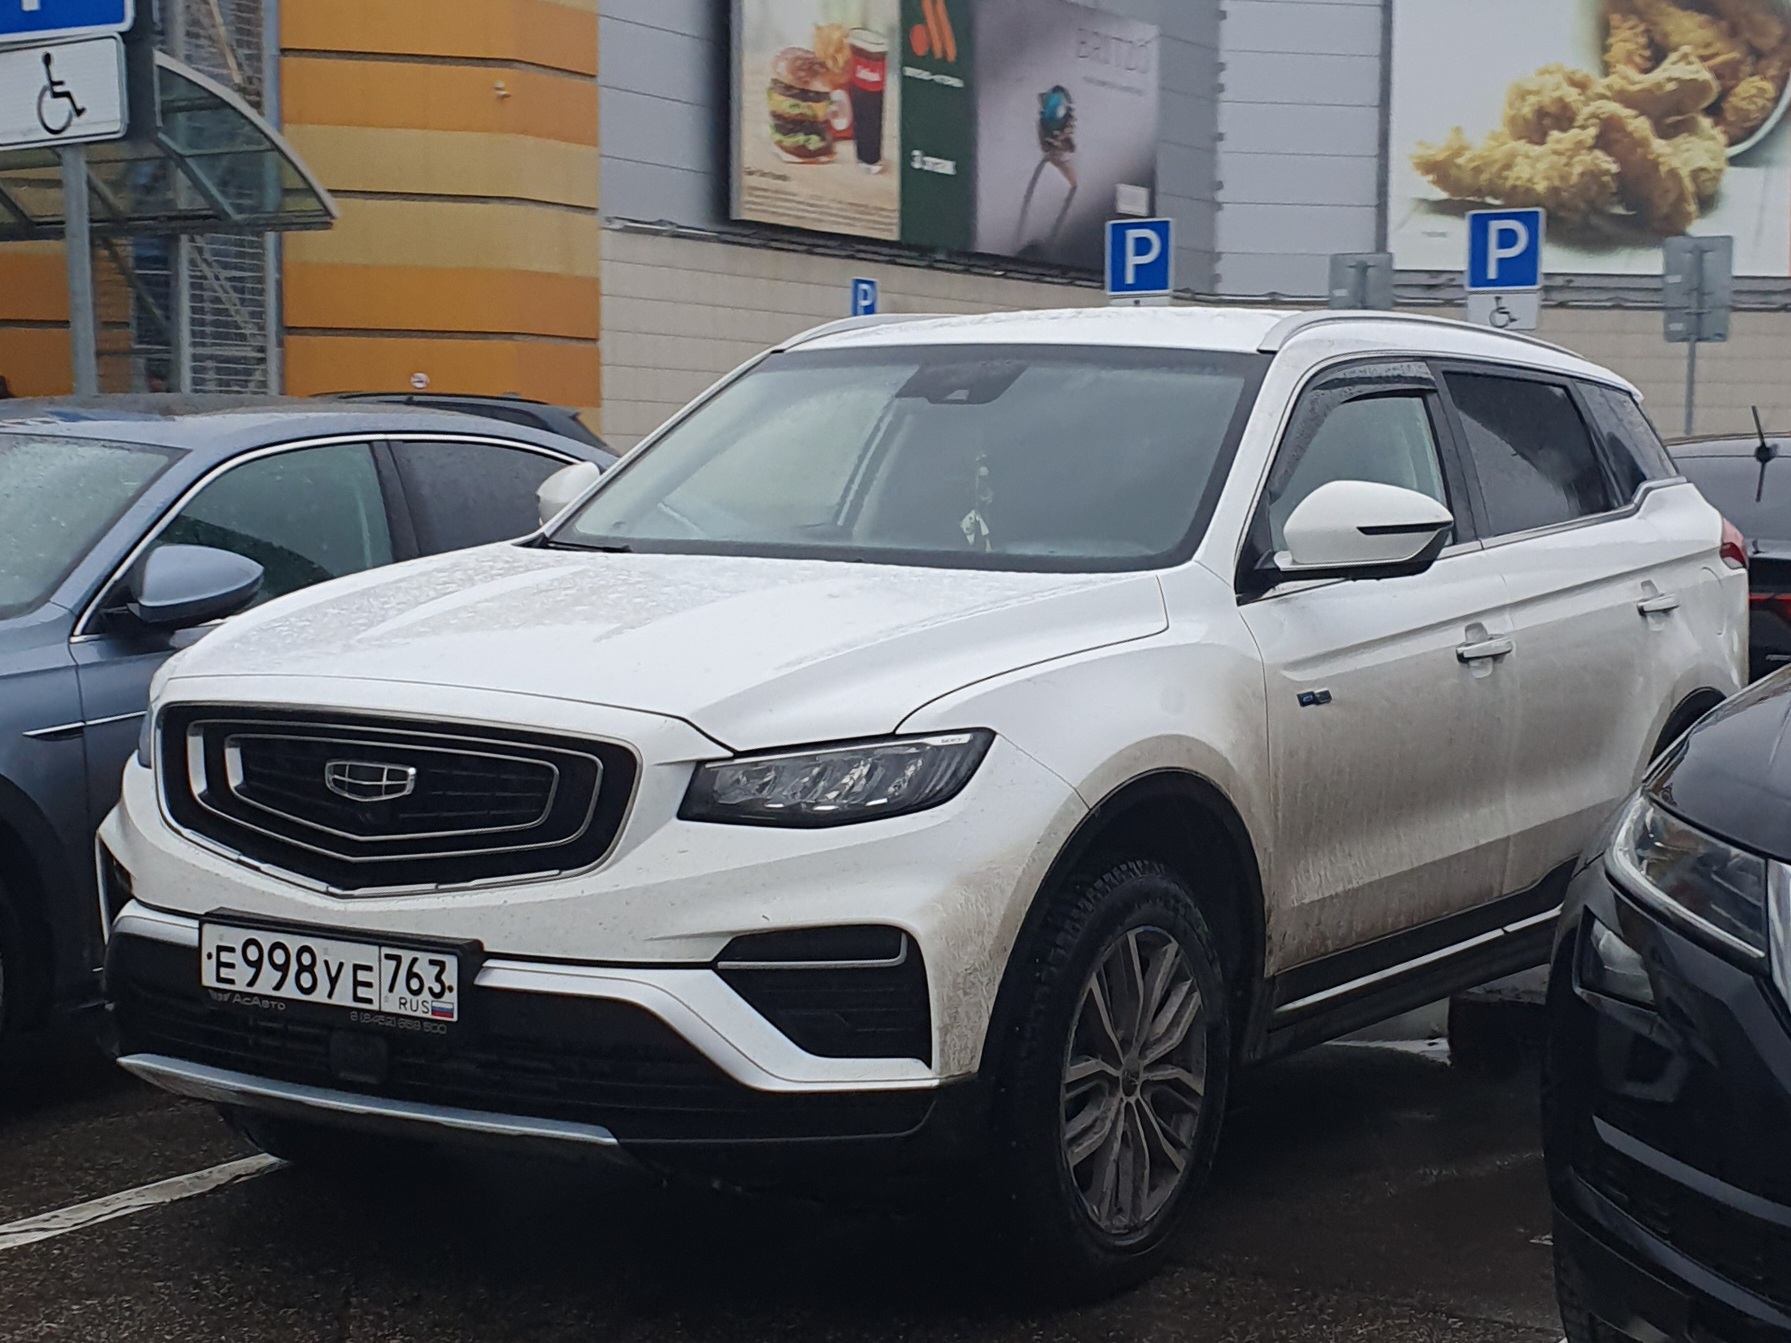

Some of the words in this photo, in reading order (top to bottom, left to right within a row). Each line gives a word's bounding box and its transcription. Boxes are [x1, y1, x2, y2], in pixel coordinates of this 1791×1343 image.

[1125, 228, 1161, 285] P
[1486, 219, 1529, 279] P
[857, 283, 873, 315] P
[384, 953, 446, 999] 763
[398, 997, 430, 1014] RUS
